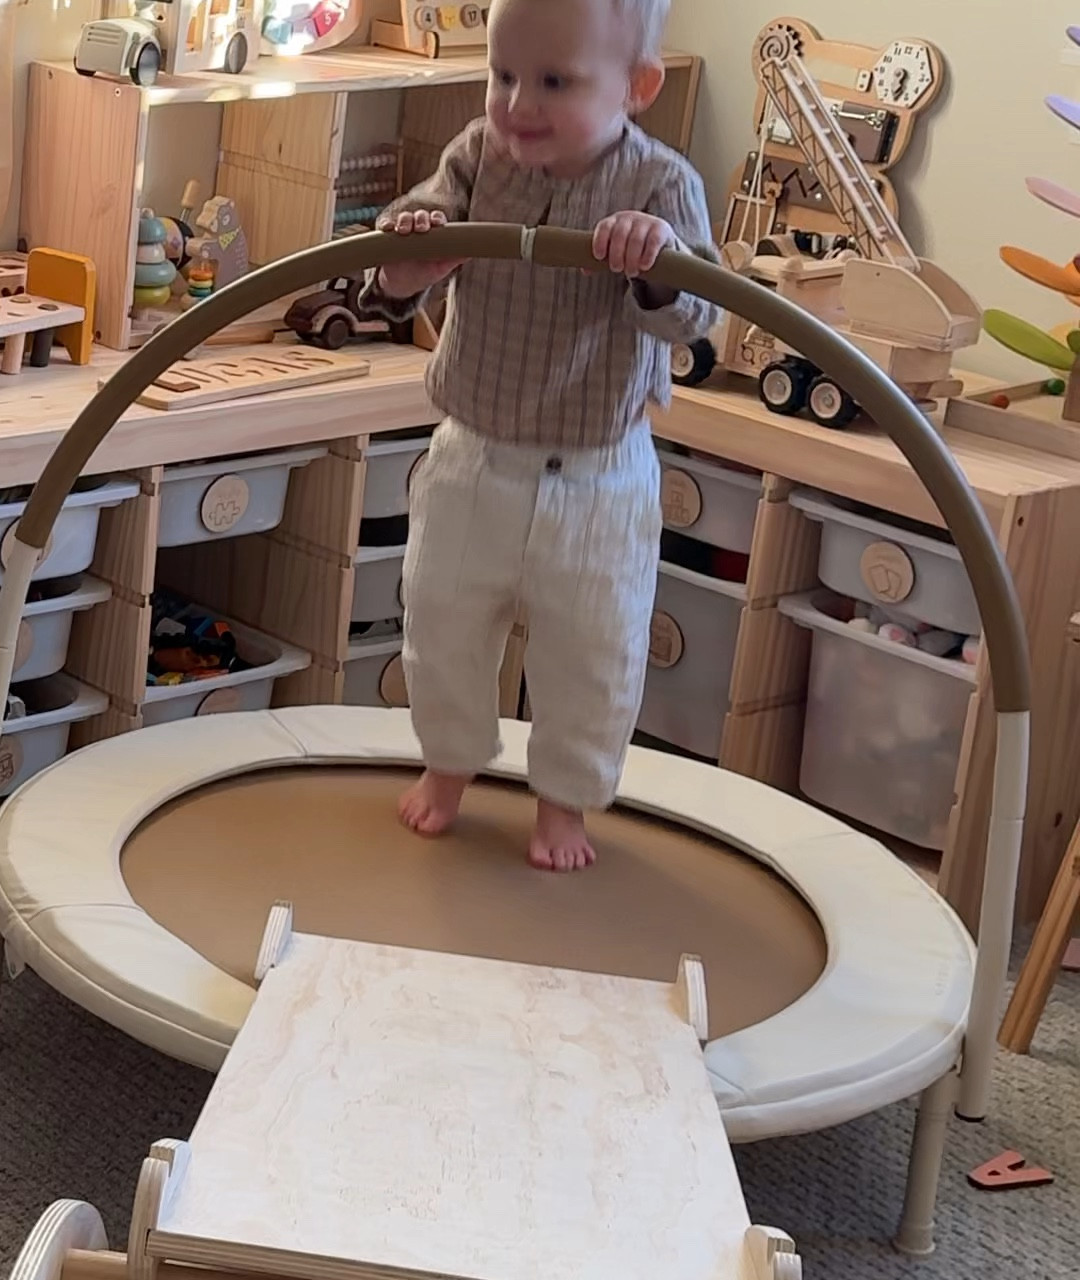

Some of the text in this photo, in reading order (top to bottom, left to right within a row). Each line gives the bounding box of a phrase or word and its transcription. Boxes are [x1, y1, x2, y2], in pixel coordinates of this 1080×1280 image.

[324, 11, 332, 26] 5
[468, 10, 477, 22] 17
[894, 47, 902, 55] 11
[904, 46, 913, 55] 12
[920, 62, 926, 70] 2
[152, 350, 335, 392] LUCAS
